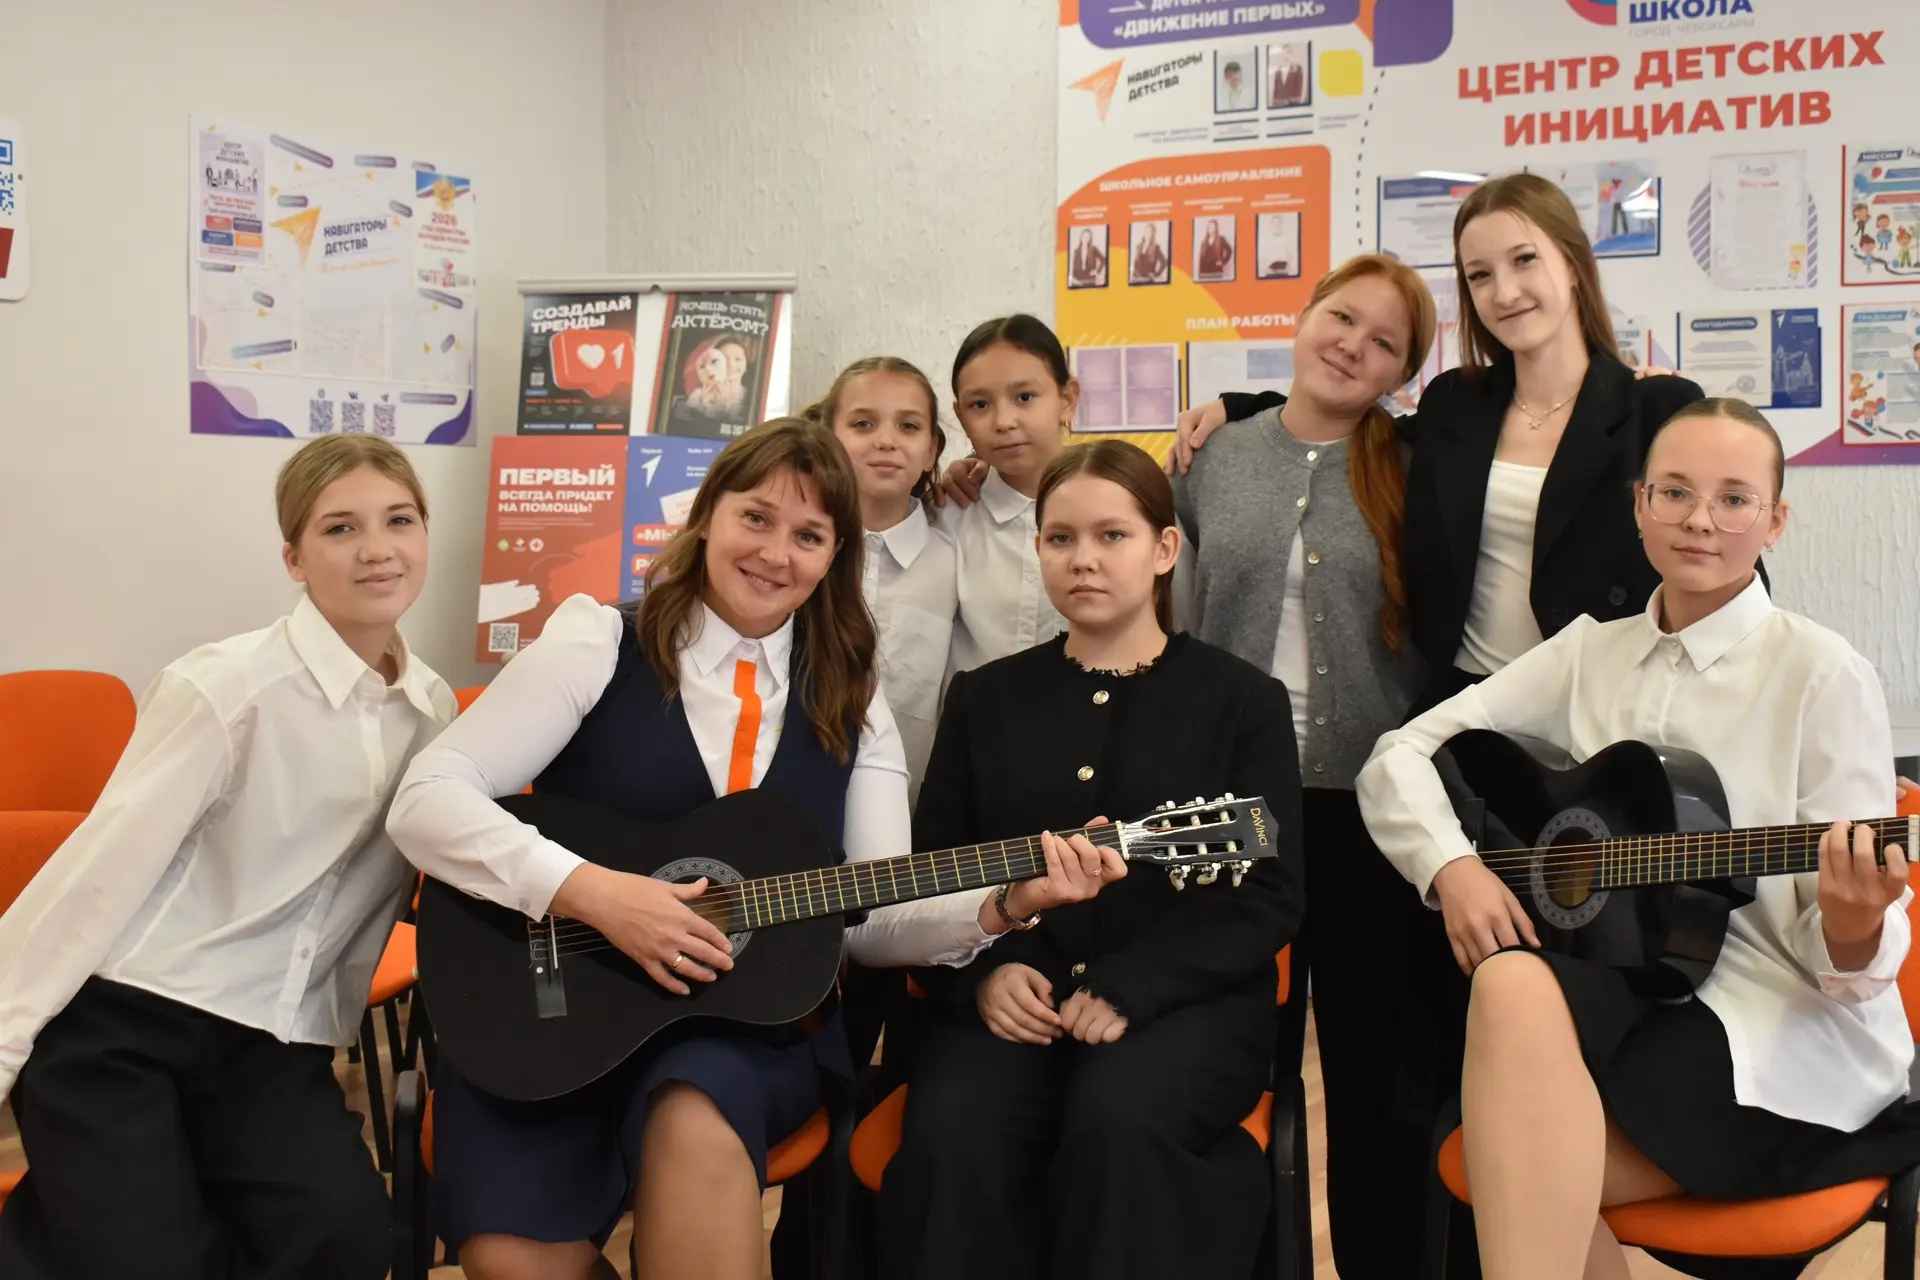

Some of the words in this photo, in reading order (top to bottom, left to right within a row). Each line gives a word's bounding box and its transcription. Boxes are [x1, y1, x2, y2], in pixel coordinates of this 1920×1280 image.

[1114, 13, 1229, 39] «ДВИЖЕНИЕ
[1233, 1, 1325, 24] ПЕРВЫХ»
[1629, 0, 1753, 24] ШКОЛА
[1127, 52, 1203, 85] НАВИГАТОРЫ
[1458, 55, 1620, 102] ЦЕНТР
[1634, 30, 1885, 90] ДЕТСКИХ
[1128, 76, 1180, 102] ДЕТСТВА
[1504, 91, 1832, 146] ИНИЦИАТИВ
[1100, 175, 1172, 192] ШКОЛЬНОЕ
[1175, 165, 1303, 185] САМОУПРАВЛЕНИЕ
[324, 219, 387, 238] НАВИГАТОРЫ
[325, 238, 368, 256] ДЕТСТВА
[532, 295, 632, 320] СОЗДАВАЙ
[531, 314, 606, 334] ТРЕНДЫ
[671, 312, 769, 336] АКТЁРОМ?
[1186, 317, 1228, 330] ПЛАН
[1231, 313, 1296, 328] РАБОТЫ
[499, 464, 616, 485] ПЕРВЫЙ
[498, 502, 518, 513] НА
[520, 502, 593, 514] ПОМОЩЬ!
[499, 490, 554, 502] ВСЕГДА
[556, 490, 614, 502] ПРИДЕТ
